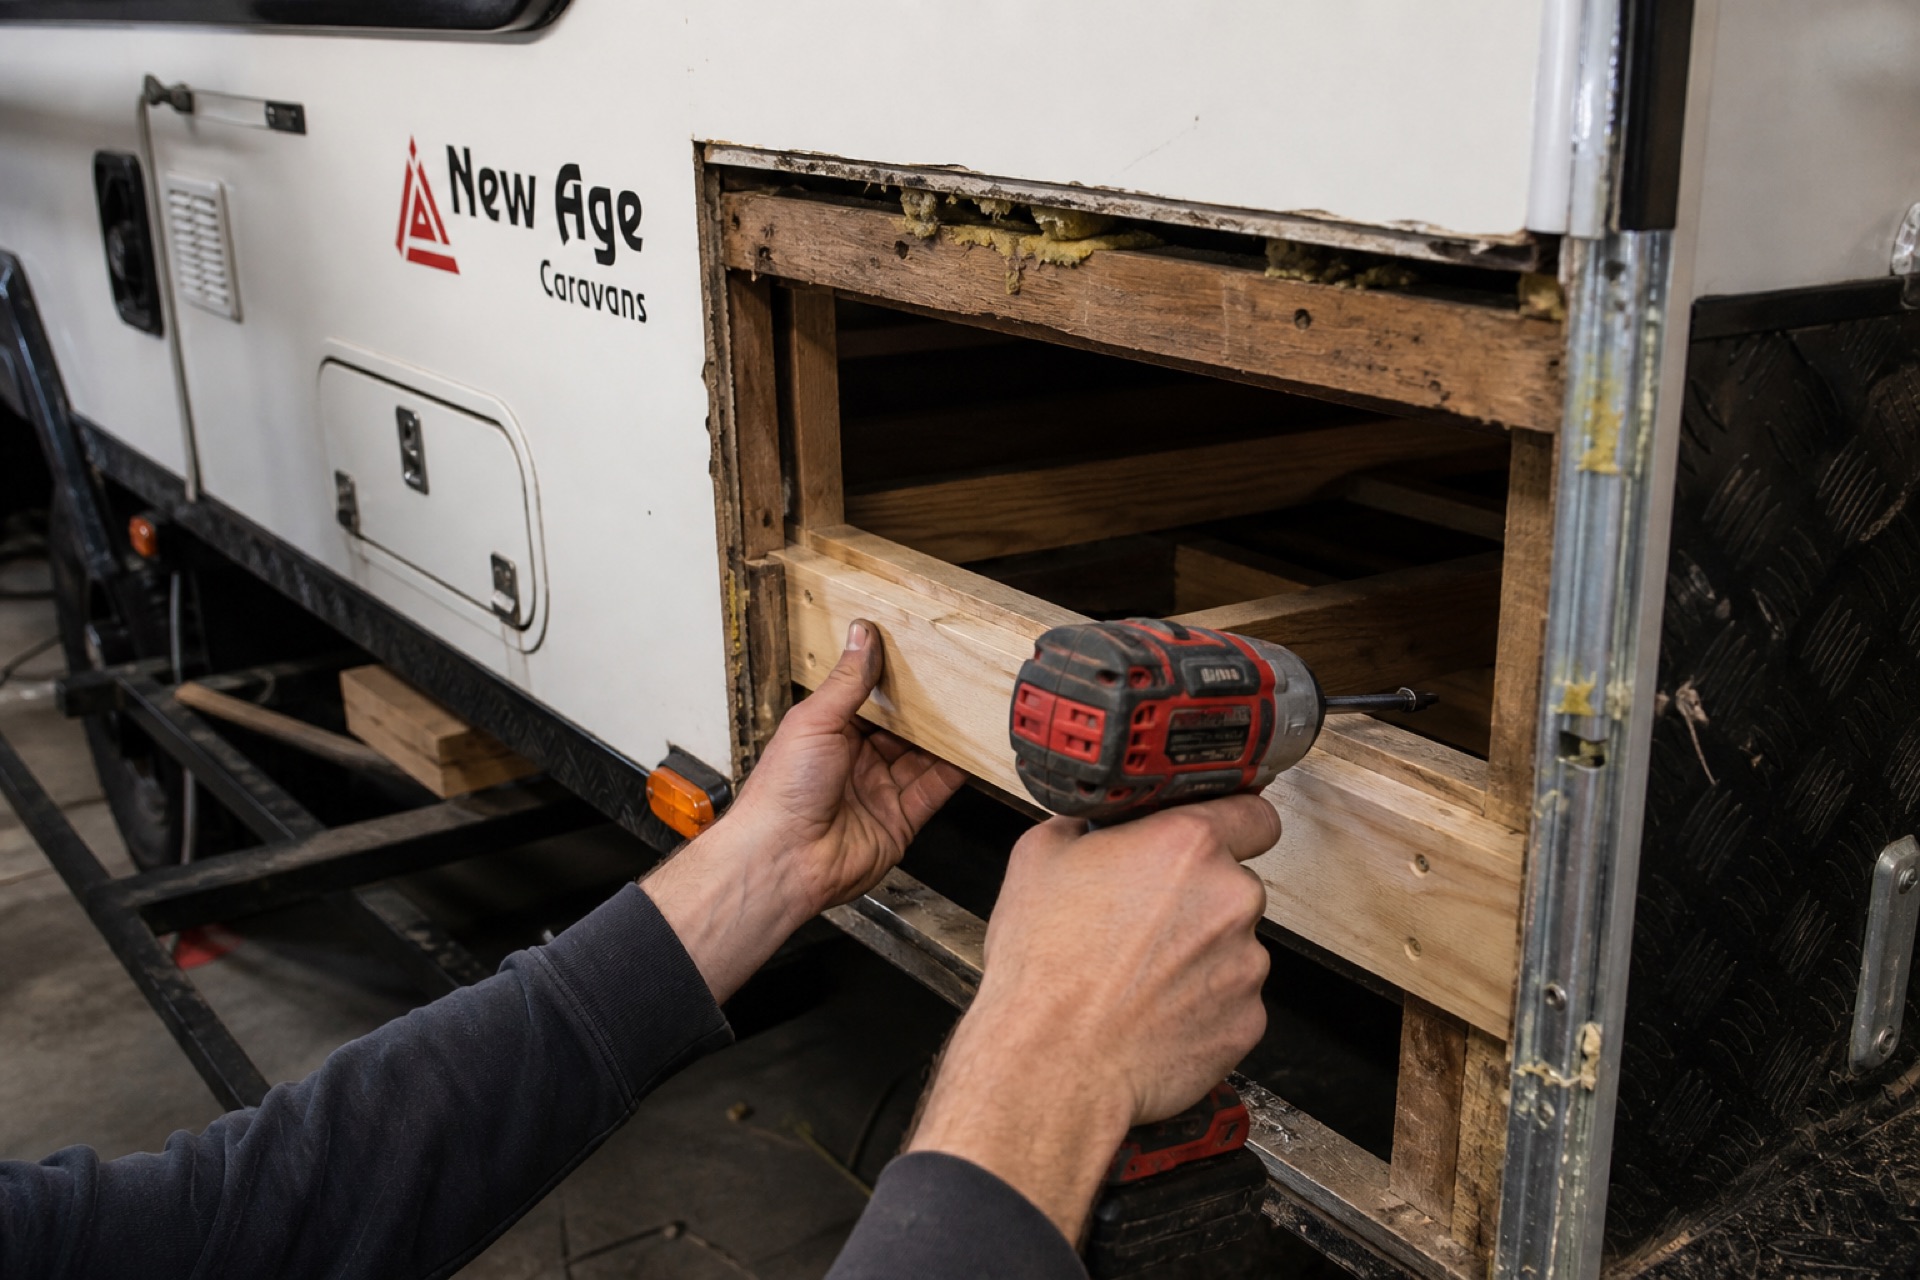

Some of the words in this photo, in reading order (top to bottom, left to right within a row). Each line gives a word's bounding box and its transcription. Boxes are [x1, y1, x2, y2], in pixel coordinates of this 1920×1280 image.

[446, 145, 536, 229] New
[555, 164, 643, 266] Age
[540, 259, 647, 323] Caravans
